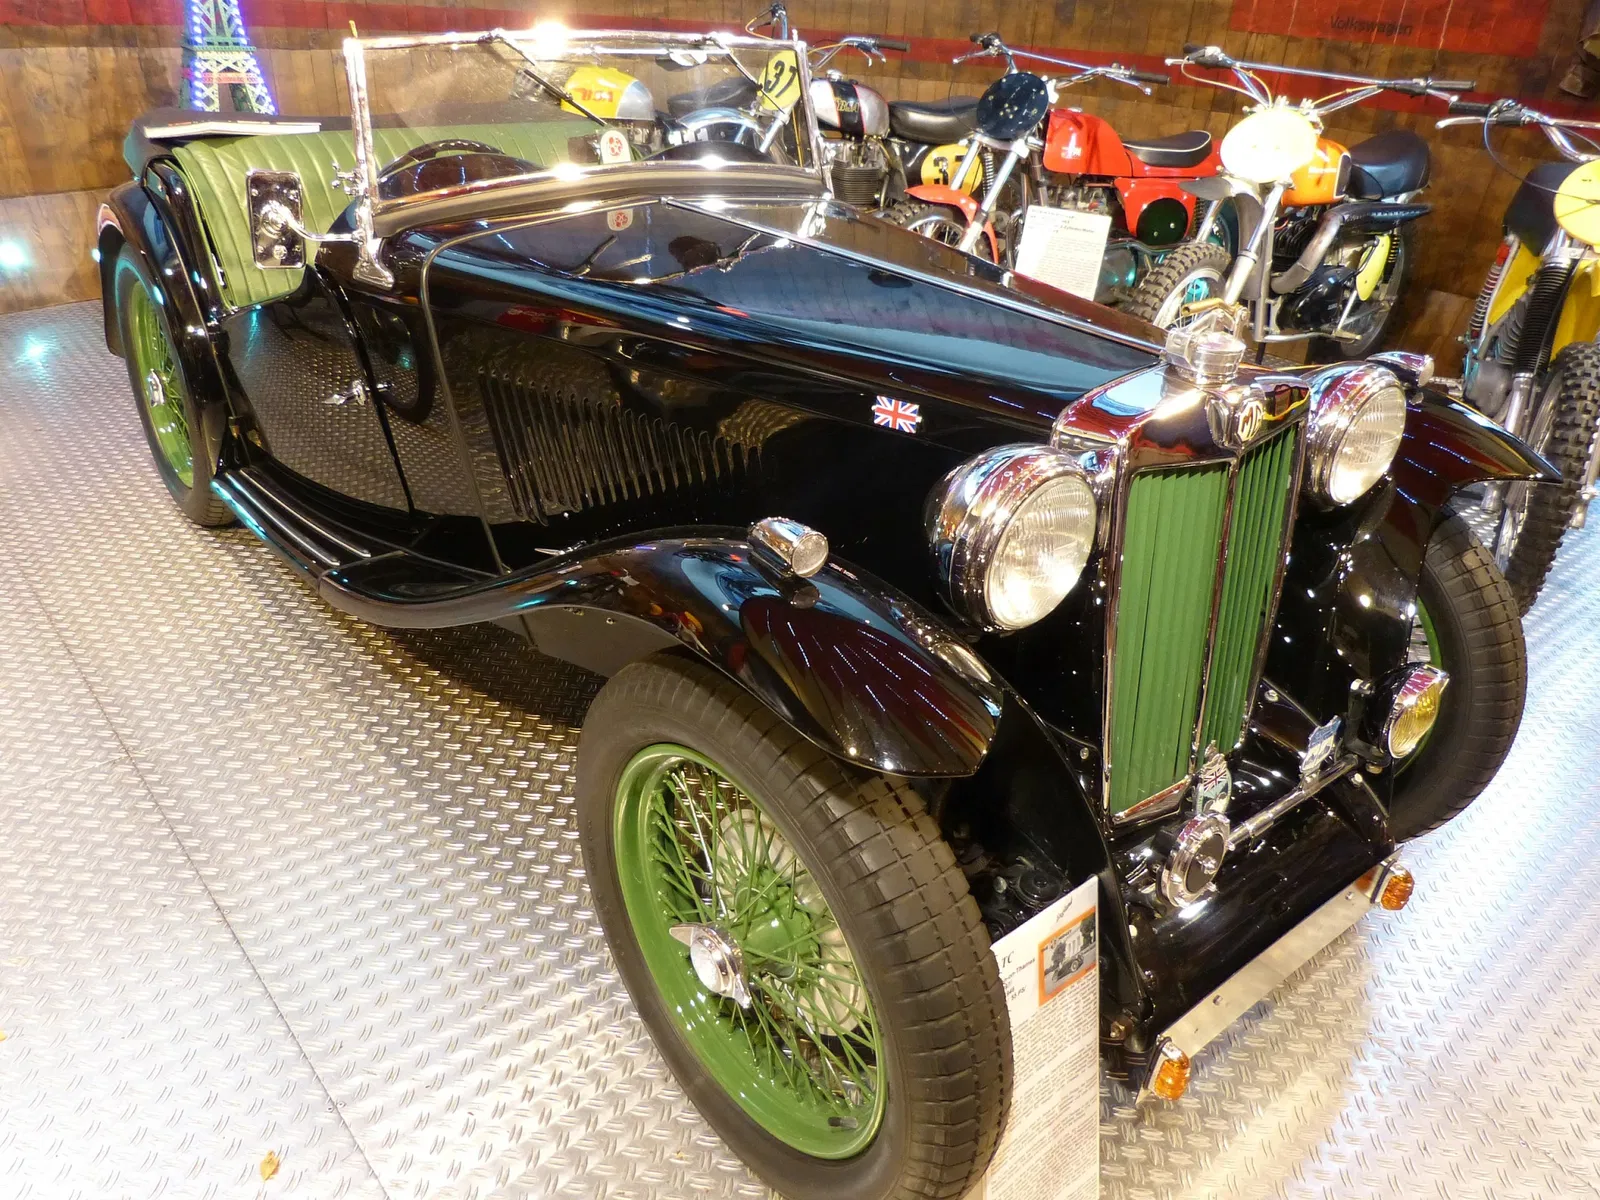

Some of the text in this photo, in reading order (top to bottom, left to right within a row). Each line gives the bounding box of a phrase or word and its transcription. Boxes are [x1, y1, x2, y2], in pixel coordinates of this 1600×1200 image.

[1330, 15, 1413, 36] Volkswagen
[764, 60, 798, 98] 37
[1239, 402, 1263, 440] MG
